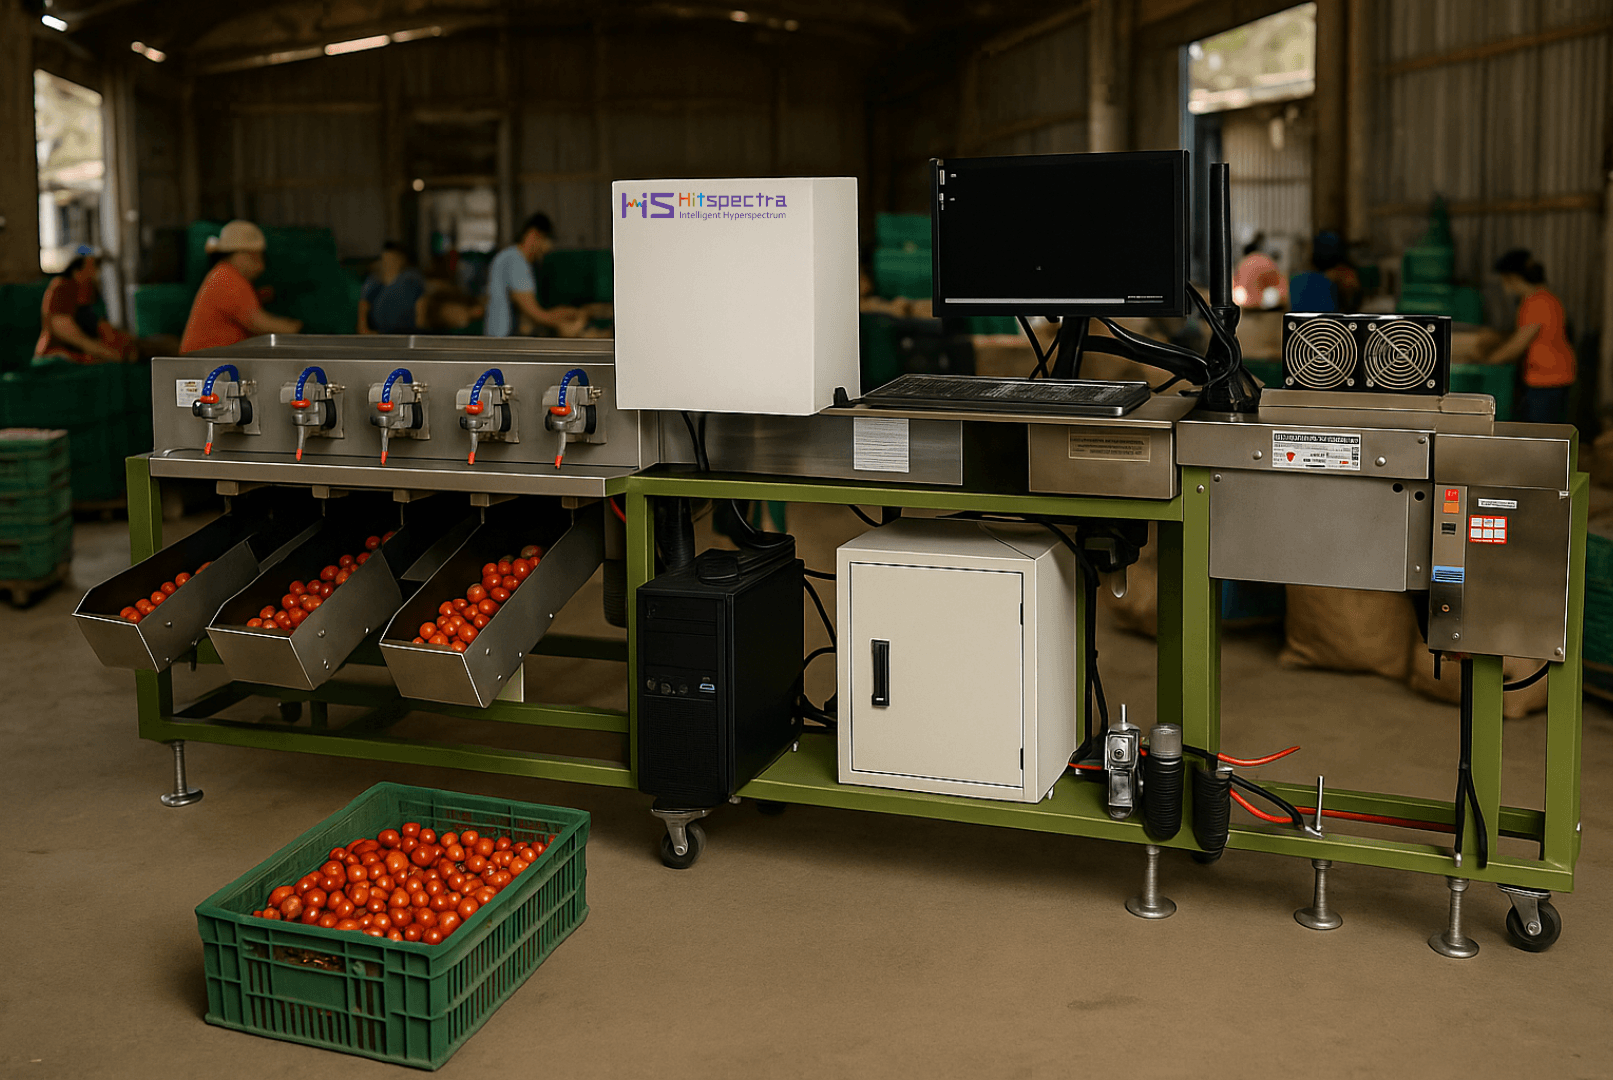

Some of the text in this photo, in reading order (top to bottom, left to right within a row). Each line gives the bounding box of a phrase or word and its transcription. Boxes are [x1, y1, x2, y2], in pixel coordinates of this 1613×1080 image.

[679, 192, 787, 210] Hitspectra
[679, 211, 786, 220] Intelligent Hyperspectrum
